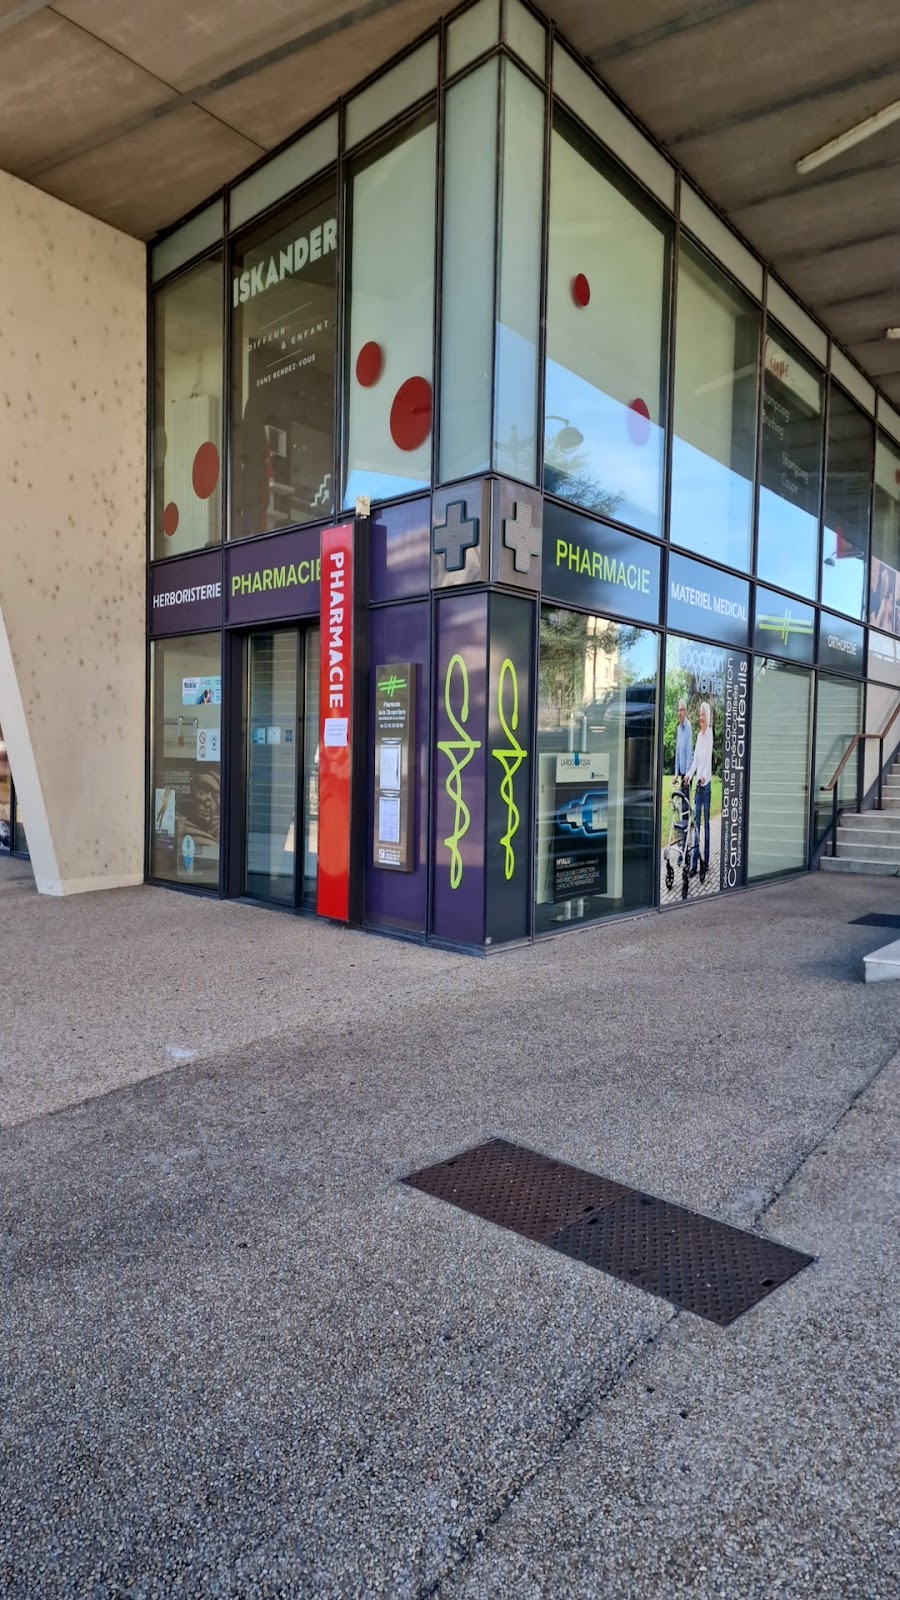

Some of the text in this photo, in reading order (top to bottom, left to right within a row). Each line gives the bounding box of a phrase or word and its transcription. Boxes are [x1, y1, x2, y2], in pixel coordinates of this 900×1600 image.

[233, 218, 337, 308] ISKANDER
[280, 320, 328, 350] & ENFANT
[256, 353, 316, 387] SANS RENDEZ-VOUS
[556, 539, 650, 594] PHARMACIE
[152, 582, 222, 609] HERBORISTERIE
[671, 581, 747, 621] MATERIEL MEDICAL
[329, 552, 345, 708] PHARMACIE
[827, 635, 857, 656] ORTHOPEDIE
[680, 642, 724, 674] Location
[694, 669, 723, 696] Vente
[724, 657, 734, 752] contention
[735, 661, 748, 770] Fauteuils
[723, 757, 731, 782] de
[722, 787, 730, 818] Bas
[728, 797, 739, 887] Cannes
